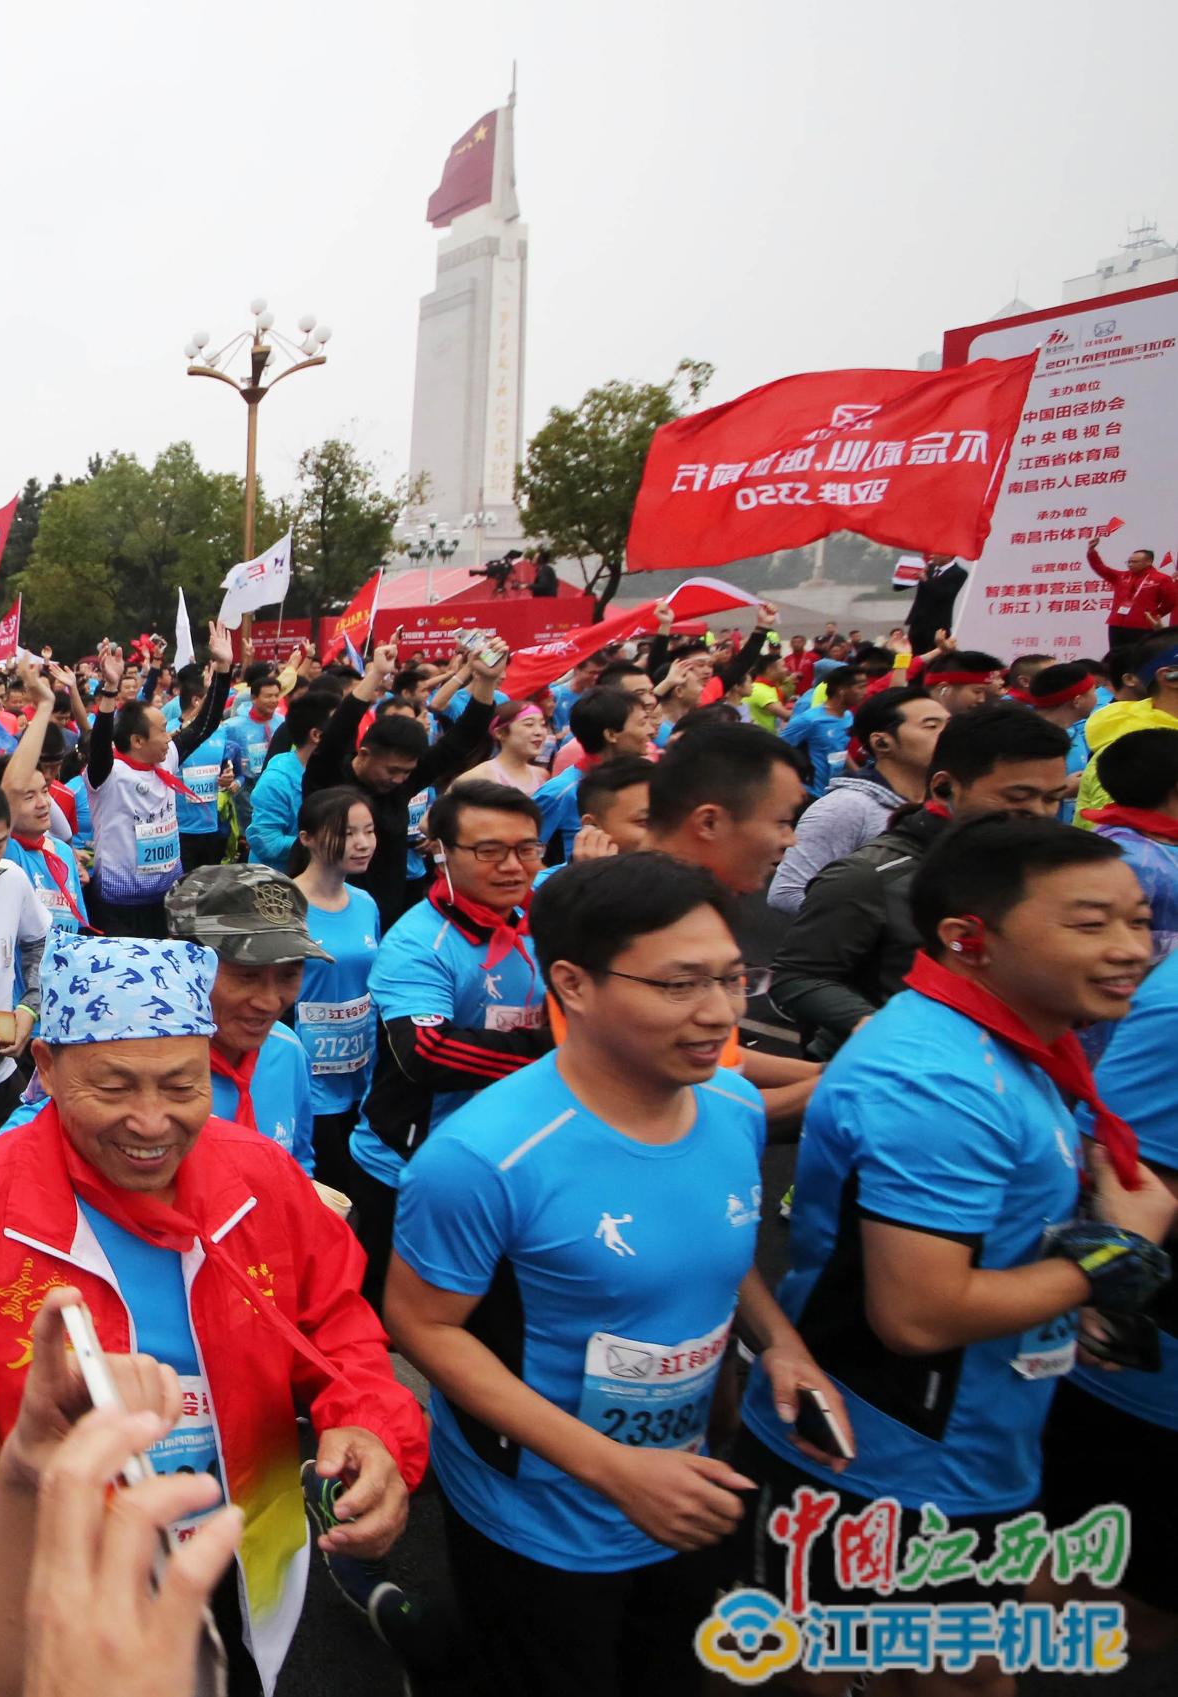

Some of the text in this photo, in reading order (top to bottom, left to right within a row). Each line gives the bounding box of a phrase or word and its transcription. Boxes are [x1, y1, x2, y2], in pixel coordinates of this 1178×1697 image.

[1049, 380, 1101, 398] 主办单位
[1023, 396, 1125, 424] 中国田径协会
[1021, 421, 1122, 448] 中央电视台
[1018, 446, 1120, 471] 江西省体育局
[1007, 469, 1127, 495] 南昌市人民政府
[1037, 507, 1088, 520] 承办单位
[1010, 525, 1111, 545] 南昌市体育局
[1032, 561, 1083, 574] 运营单位
[314, 1032, 364, 1058] 27231
